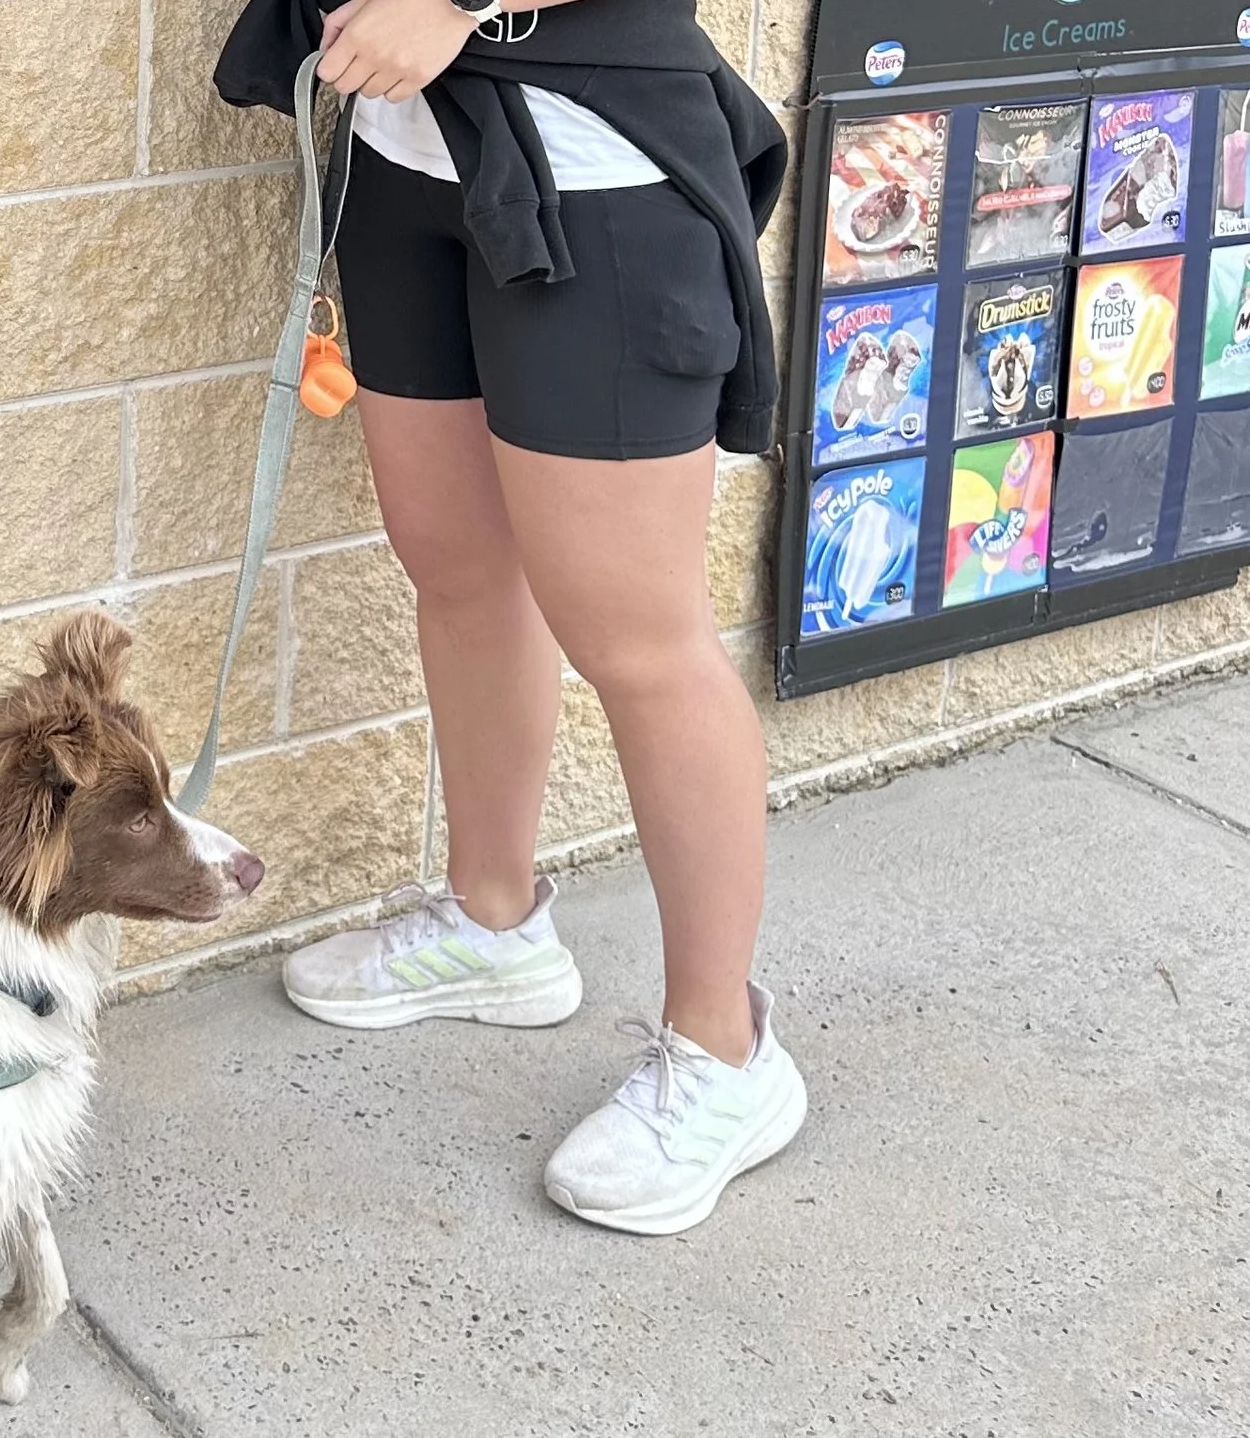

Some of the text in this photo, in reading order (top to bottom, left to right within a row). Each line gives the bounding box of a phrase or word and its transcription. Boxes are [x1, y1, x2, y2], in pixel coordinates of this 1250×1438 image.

[1003, 18, 1126, 53] Ice Creams
[867, 53, 905, 74] Peters
[998, 106, 1076, 122] CONNOISSEUR
[1098, 103, 1154, 148] MAXIBON
[922, 115, 946, 269] CONNOISSEUR
[982, 291, 1050, 329] Drumstick
[1093, 298, 1136, 319] frosty
[826, 304, 892, 355] MAXIBON
[1091, 318, 1135, 340] fruits
